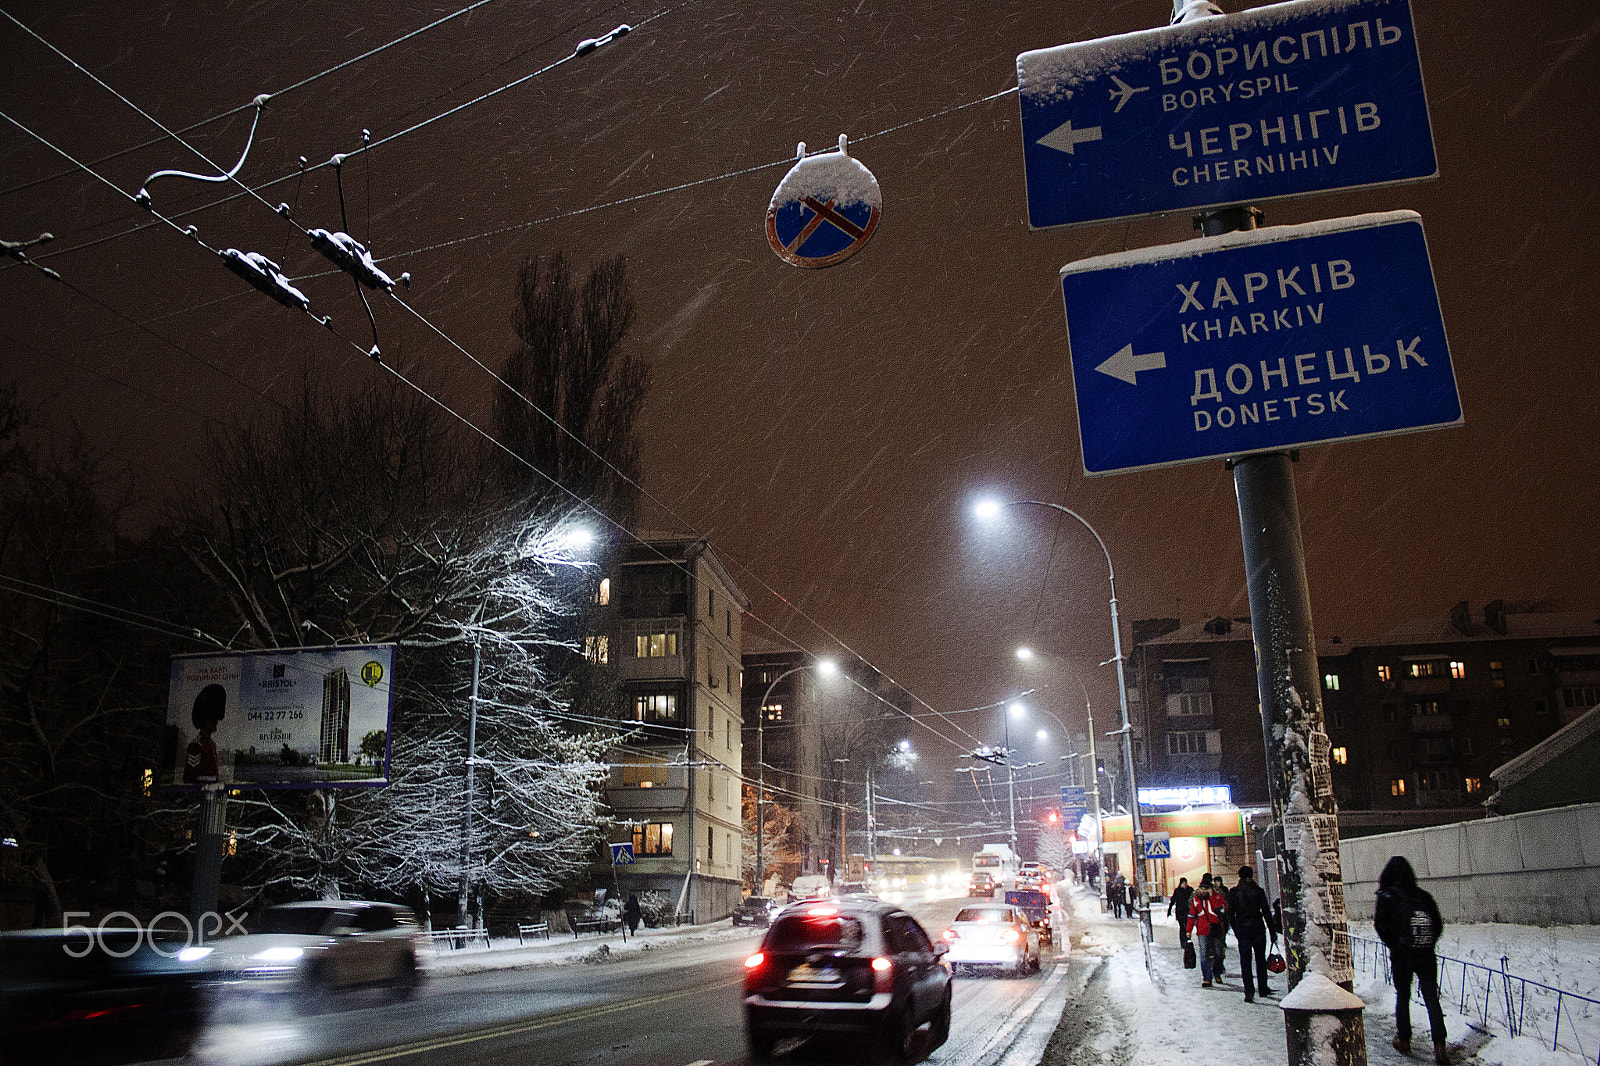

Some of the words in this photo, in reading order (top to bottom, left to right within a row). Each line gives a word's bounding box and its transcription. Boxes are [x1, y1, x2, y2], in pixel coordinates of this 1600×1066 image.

[1159, 17, 1403, 86] БОРИСПІЛЬ
[1162, 74, 1299, 112] BORYSPIL
[1168, 101, 1383, 158] ЧЕРНІГІВ
[1172, 144, 1341, 187] CHERNIHIV
[1175, 258, 1356, 314] ХАРКІВ
[1181, 303, 1325, 344] KHARKIV
[1190, 336, 1429, 405] ДОНЕЦЬК
[1193, 390, 1350, 432] DONETSK
[264, 711, 274, 720] 22
